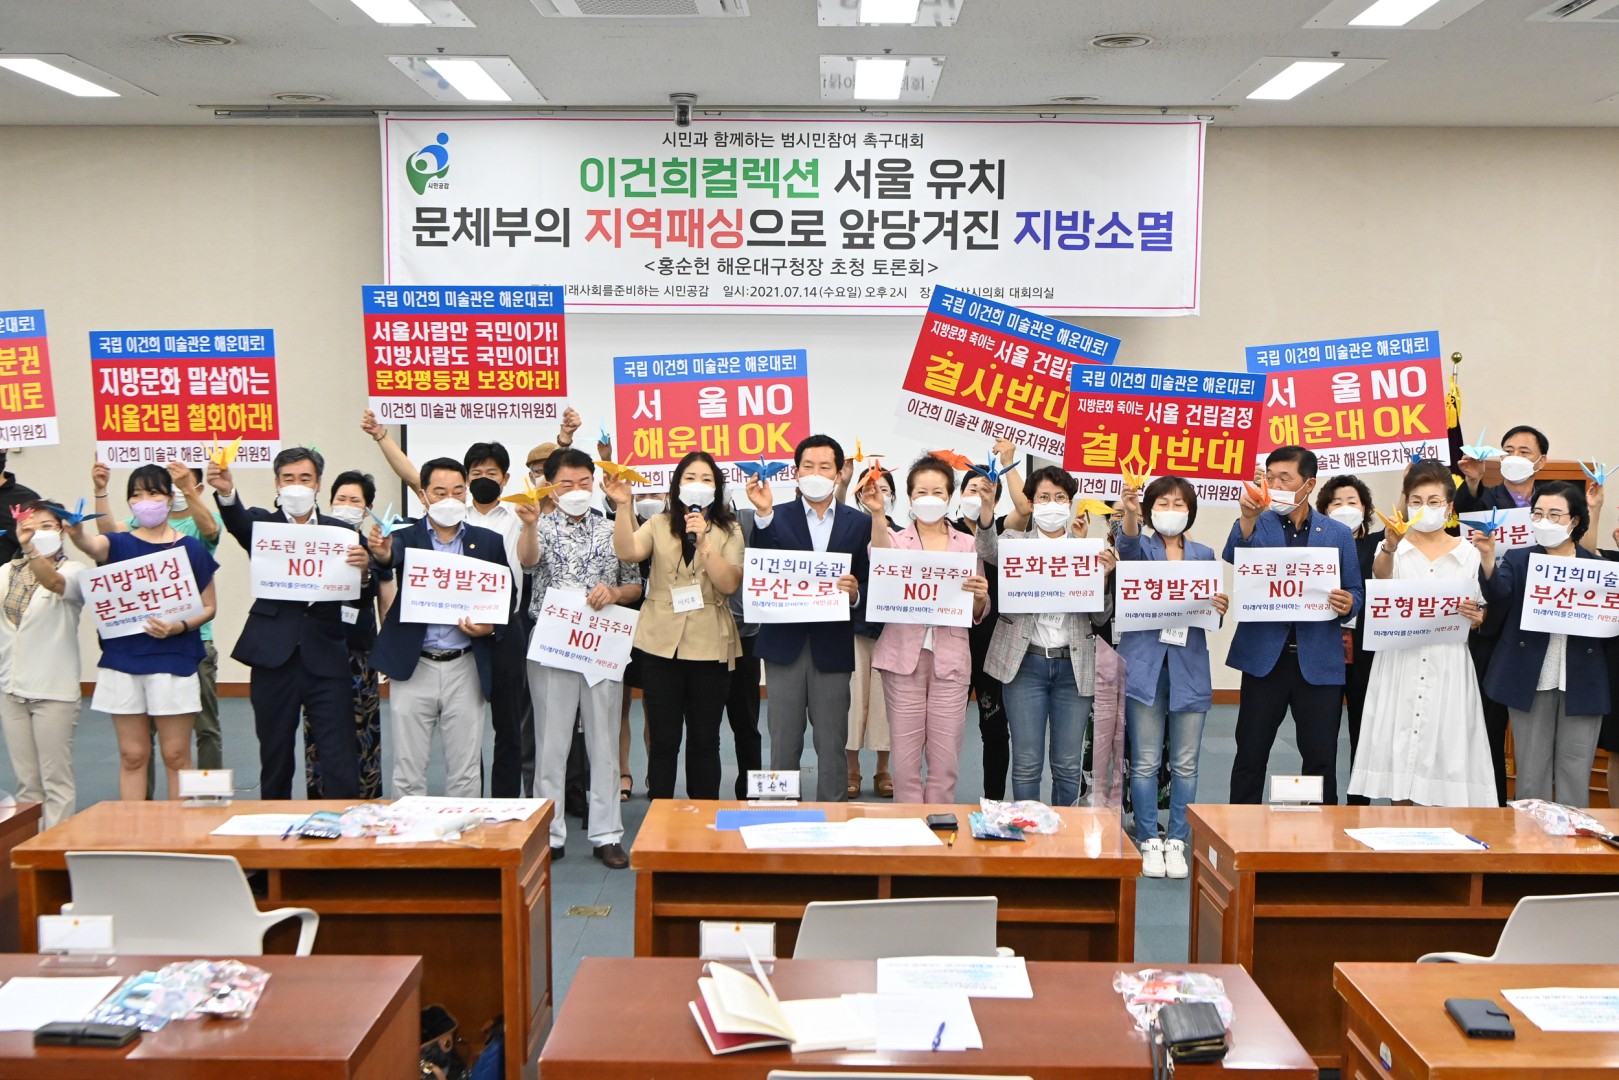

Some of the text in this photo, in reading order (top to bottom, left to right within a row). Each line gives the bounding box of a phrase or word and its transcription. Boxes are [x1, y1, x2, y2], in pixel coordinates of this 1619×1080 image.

[662, 131, 924, 149] 시민과 함께하는 범시민참여 촉구대회
[580, 157, 1006, 200] 이건희컬렉션 서울 유치
[412, 207, 1174, 252] 문체부의 지역패싱으로 앞당겨진 지방소멸
[644, 257, 939, 277] <홍순헌 해운대구청장 초청 토론회>
[373, 290, 553, 307] 국립 이건희 미술관은 해운대로!
[564, 284, 660, 297] 래사회를준비하는
[664, 285, 709, 298] 시민공감
[1009, 287, 1055, 299] 대회의실
[373, 322, 558, 342] 서울사람만 국민이가!
[941, 293, 1109, 357] 국립 이건희 미술관은 해운대로!
[100, 335, 265, 353] 국립 이건희 미술관은 해운대로!
[931, 320, 968, 343] 지방문화
[968, 332, 996, 351] 죽이는
[994, 340, 1031, 366] 서울
[1257, 337, 1429, 367] 국립 이건희 미술관은 해운대로!
[374, 346, 559, 366] 지방사람도 국민이다!
[624, 355, 797, 377] 국립 이건희 미술관은 해운대로!
[100, 366, 269, 396] 지방문화 말살하는
[376, 370, 560, 390] 문화평등권 보장하라!
[1082, 370, 1255, 395] 국립 이건희 미술관은 해운대로!
[102, 403, 273, 432] 서울건립 철회하라!
[381, 402, 557, 419] 이건희 미술관 해운대유치위원회
[907, 398, 943, 422] 이건희
[944, 408, 980, 432] 미술관
[1077, 398, 1253, 429] 지방문화 죽이는 서울 건립결정
[1269, 403, 1431, 446] 해운대 OK
[738, 422, 795, 455] OK
[108, 446, 140, 462] 이건희
[144, 446, 177, 462] 미술관
[1081, 425, 1245, 475] 결사반대
[1317, 453, 1340, 470] 술관
[256, 539, 350, 556] 수도권 일극주
[90, 557, 180, 592] 지방패싱
[288, 559, 323, 577] NO!
[751, 558, 846, 577] 이건희미술관
[873, 564, 973, 580] 수도권 일극주의
[1003, 555, 1099, 578] 문화분권!
[1237, 563, 1337, 576] 수도권 일극주의
[1535, 564, 1619, 588] 이건희미술
[408, 566, 506, 593] 균형발전!
[1121, 578, 1219, 600] 균형발전!
[1269, 580, 1304, 597] NO!
[95, 580, 193, 621] 분노한다!
[904, 583, 938, 601] NO!
[544, 604, 634, 637] 수도권 일극주의
[568, 629, 602, 652] NO!
